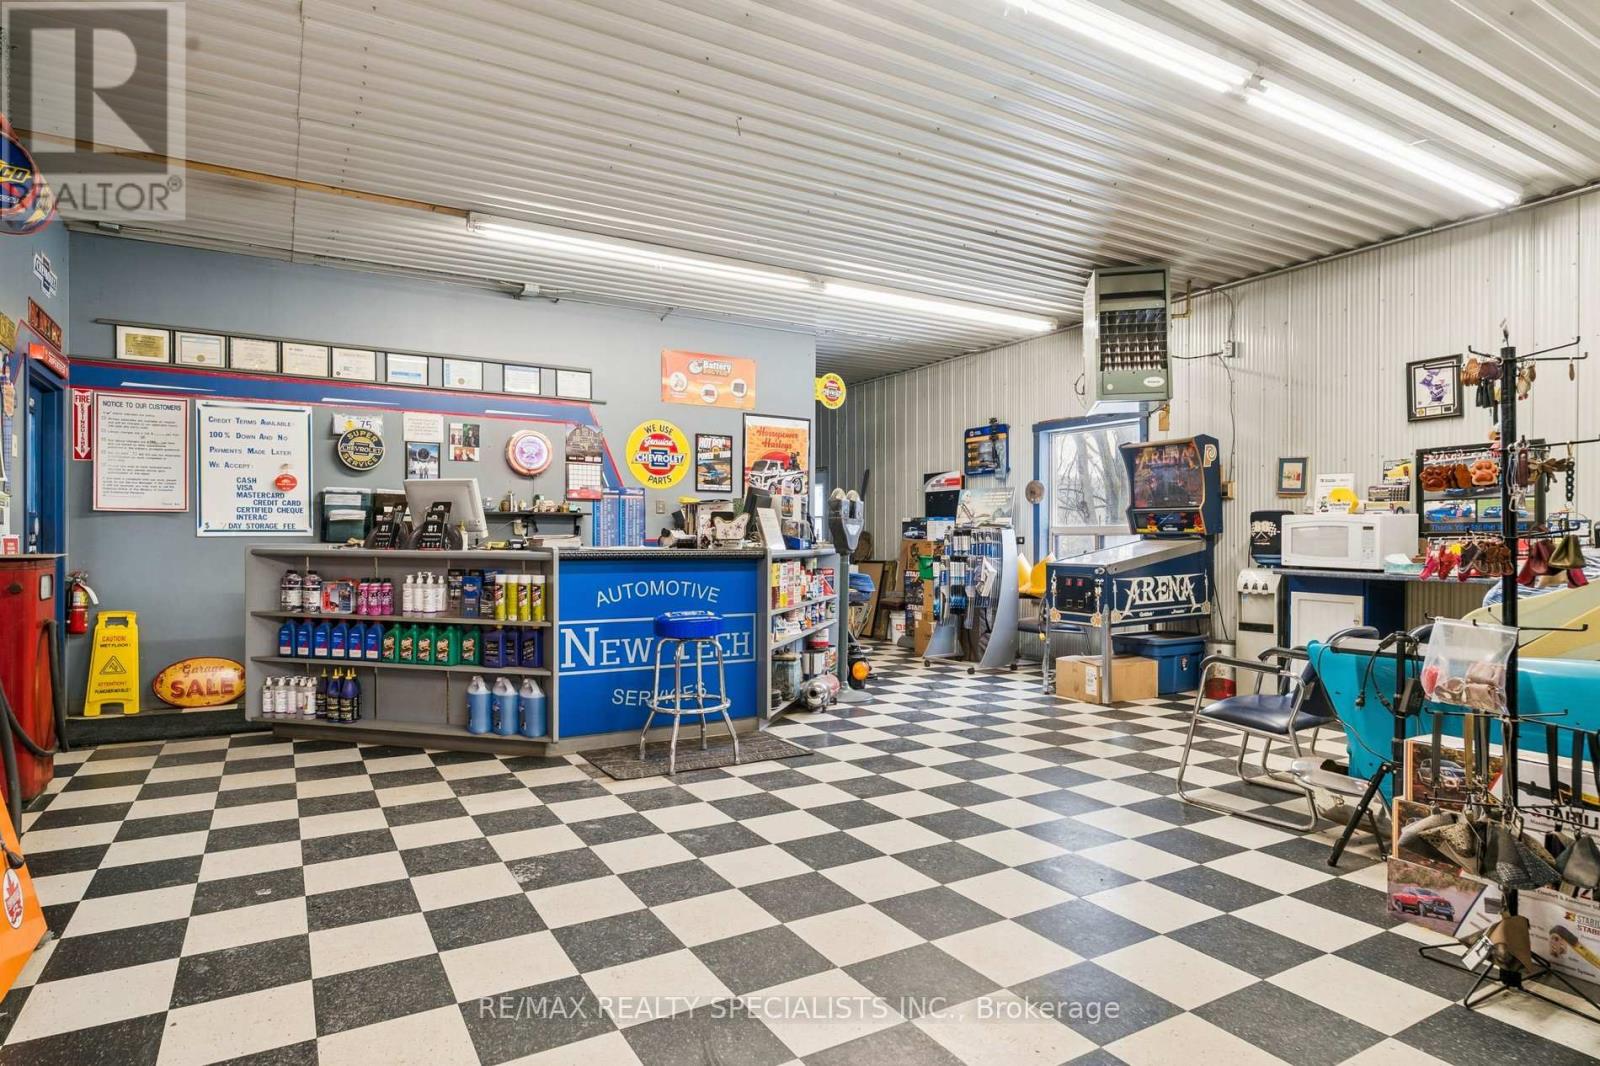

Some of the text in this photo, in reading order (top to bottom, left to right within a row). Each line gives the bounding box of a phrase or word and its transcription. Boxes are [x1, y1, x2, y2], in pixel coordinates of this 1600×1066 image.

[75, 394, 90, 404] FIRE
[148, 403, 182, 411] CUSTOMERS
[644, 424, 674, 435] WE USE
[347, 430, 378, 442] SUPER
[644, 436, 673, 448] Genuine
[340, 442, 384, 455] CHEVROLET
[342, 452, 378, 468] SERVICE
[636, 452, 684, 464] CHEVROLET
[648, 475, 672, 484] PARTS
[428, 524, 438, 533] #1
[596, 580, 720, 608] AUTOMOTIVE
[1121, 575, 1197, 613] ARENA
[674, 630, 750, 661] ECH
[182, 663, 225, 678] Garage
[170, 679, 234, 699] SALE
